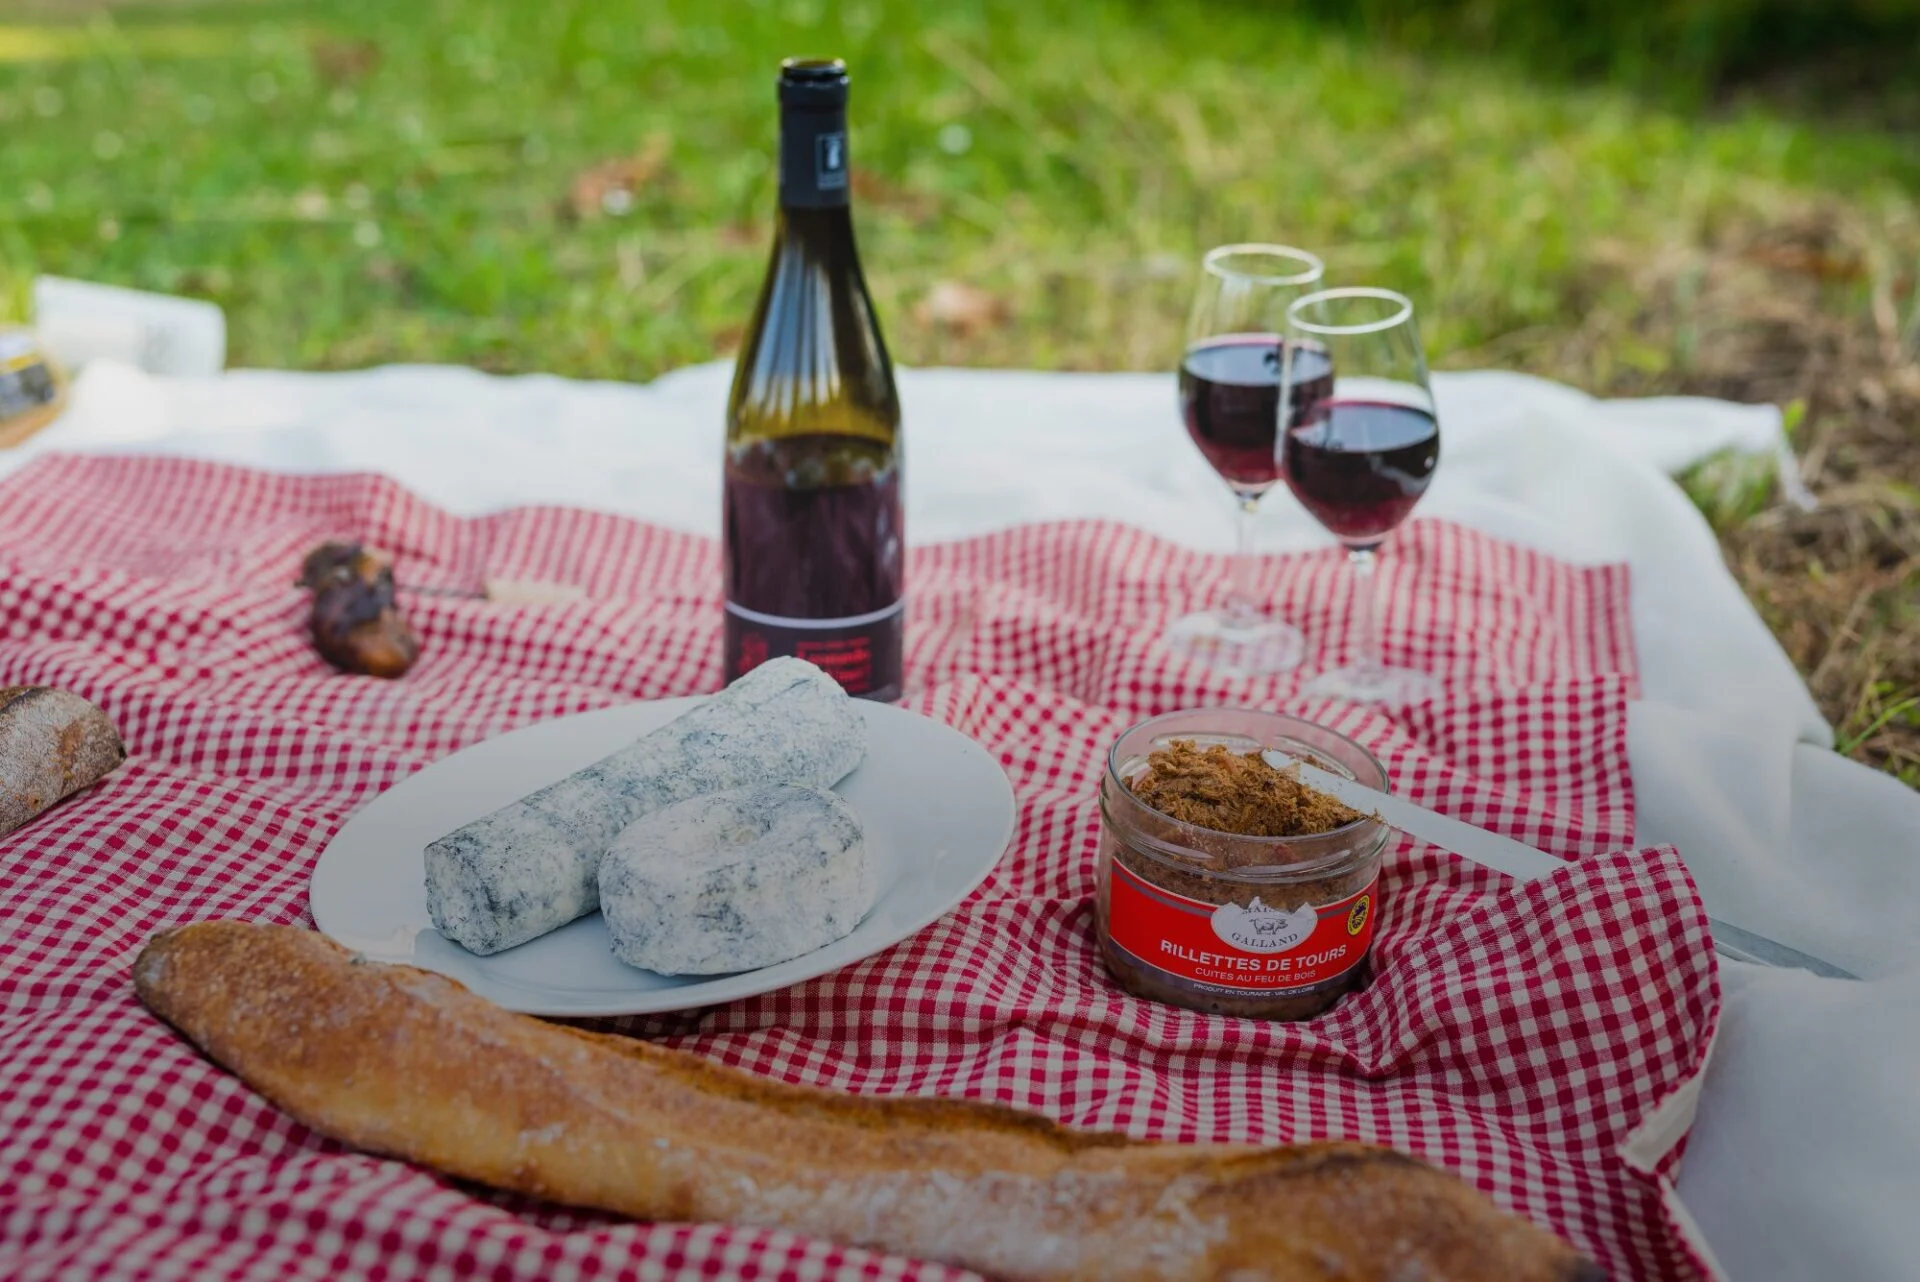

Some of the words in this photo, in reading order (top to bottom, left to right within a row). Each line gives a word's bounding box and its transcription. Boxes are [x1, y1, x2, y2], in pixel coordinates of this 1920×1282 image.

[1231, 932, 1298, 948] GALLAND
[1160, 939, 1261, 971] RILLETTES
[1266, 958, 1291, 971] DE
[1296, 944, 1347, 969] TOURS
[1195, 967, 1234, 981] CUITES
[1236, 974, 1252, 983] AU
[1254, 975, 1276, 983] FEU
[1278, 974, 1291, 983] DE
[1293, 969, 1316, 981] BOIS
[1193, 983, 1224, 993] PRODUIT
